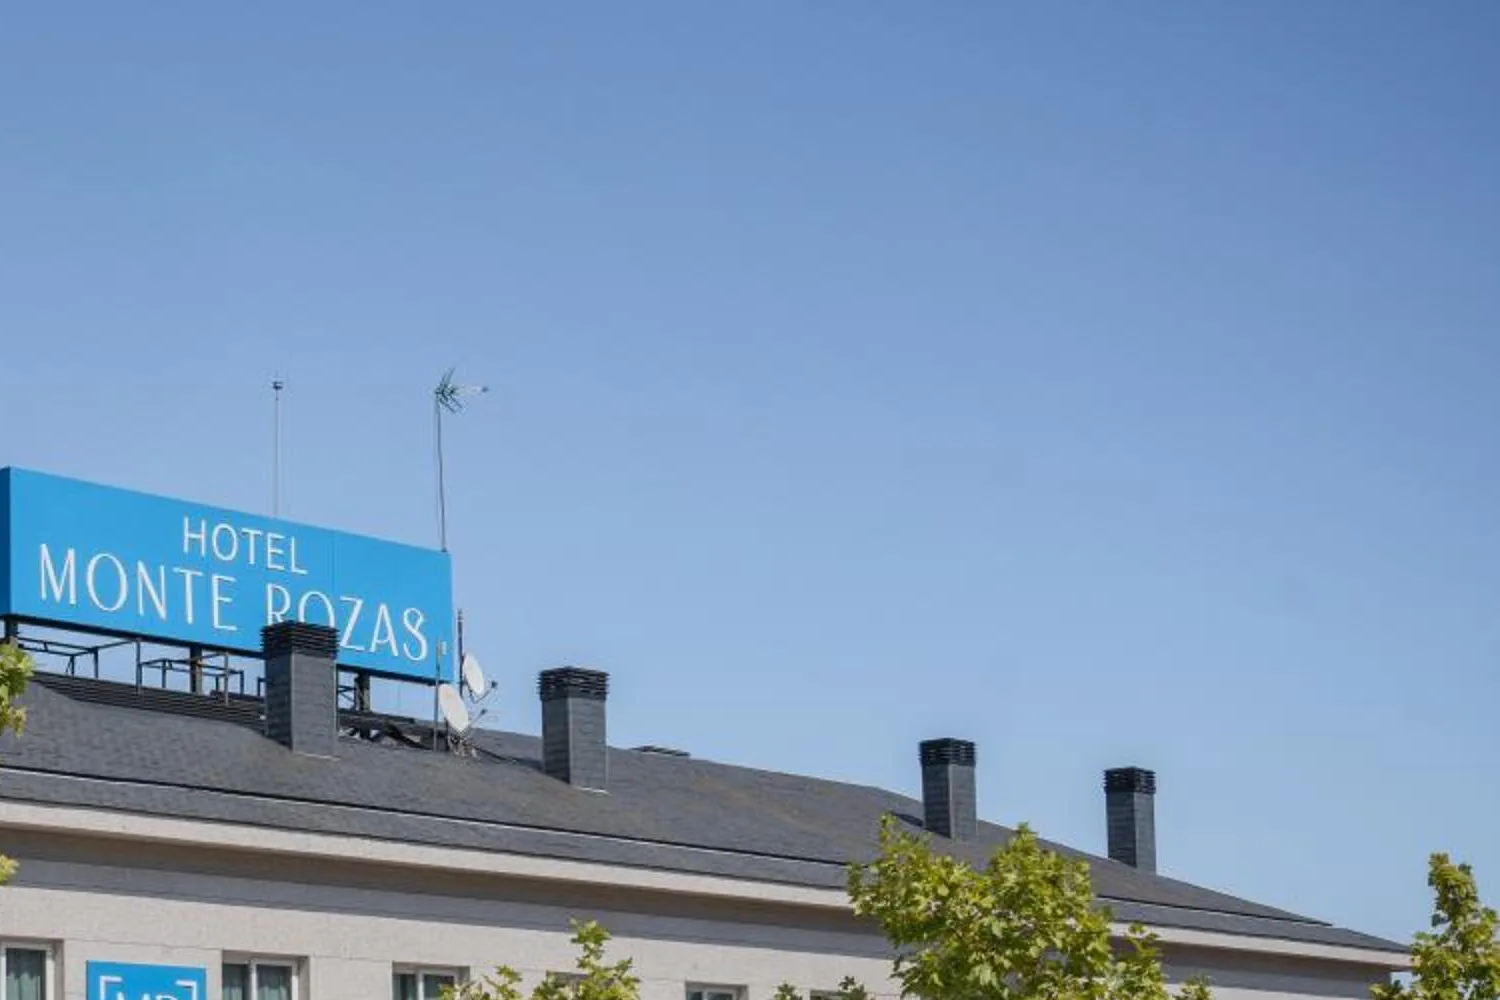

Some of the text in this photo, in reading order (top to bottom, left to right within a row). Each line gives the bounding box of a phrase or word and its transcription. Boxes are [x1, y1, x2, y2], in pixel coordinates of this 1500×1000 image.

[183, 516, 308, 575] HOTEL
[39, 543, 429, 661] MONTE ROZAS
